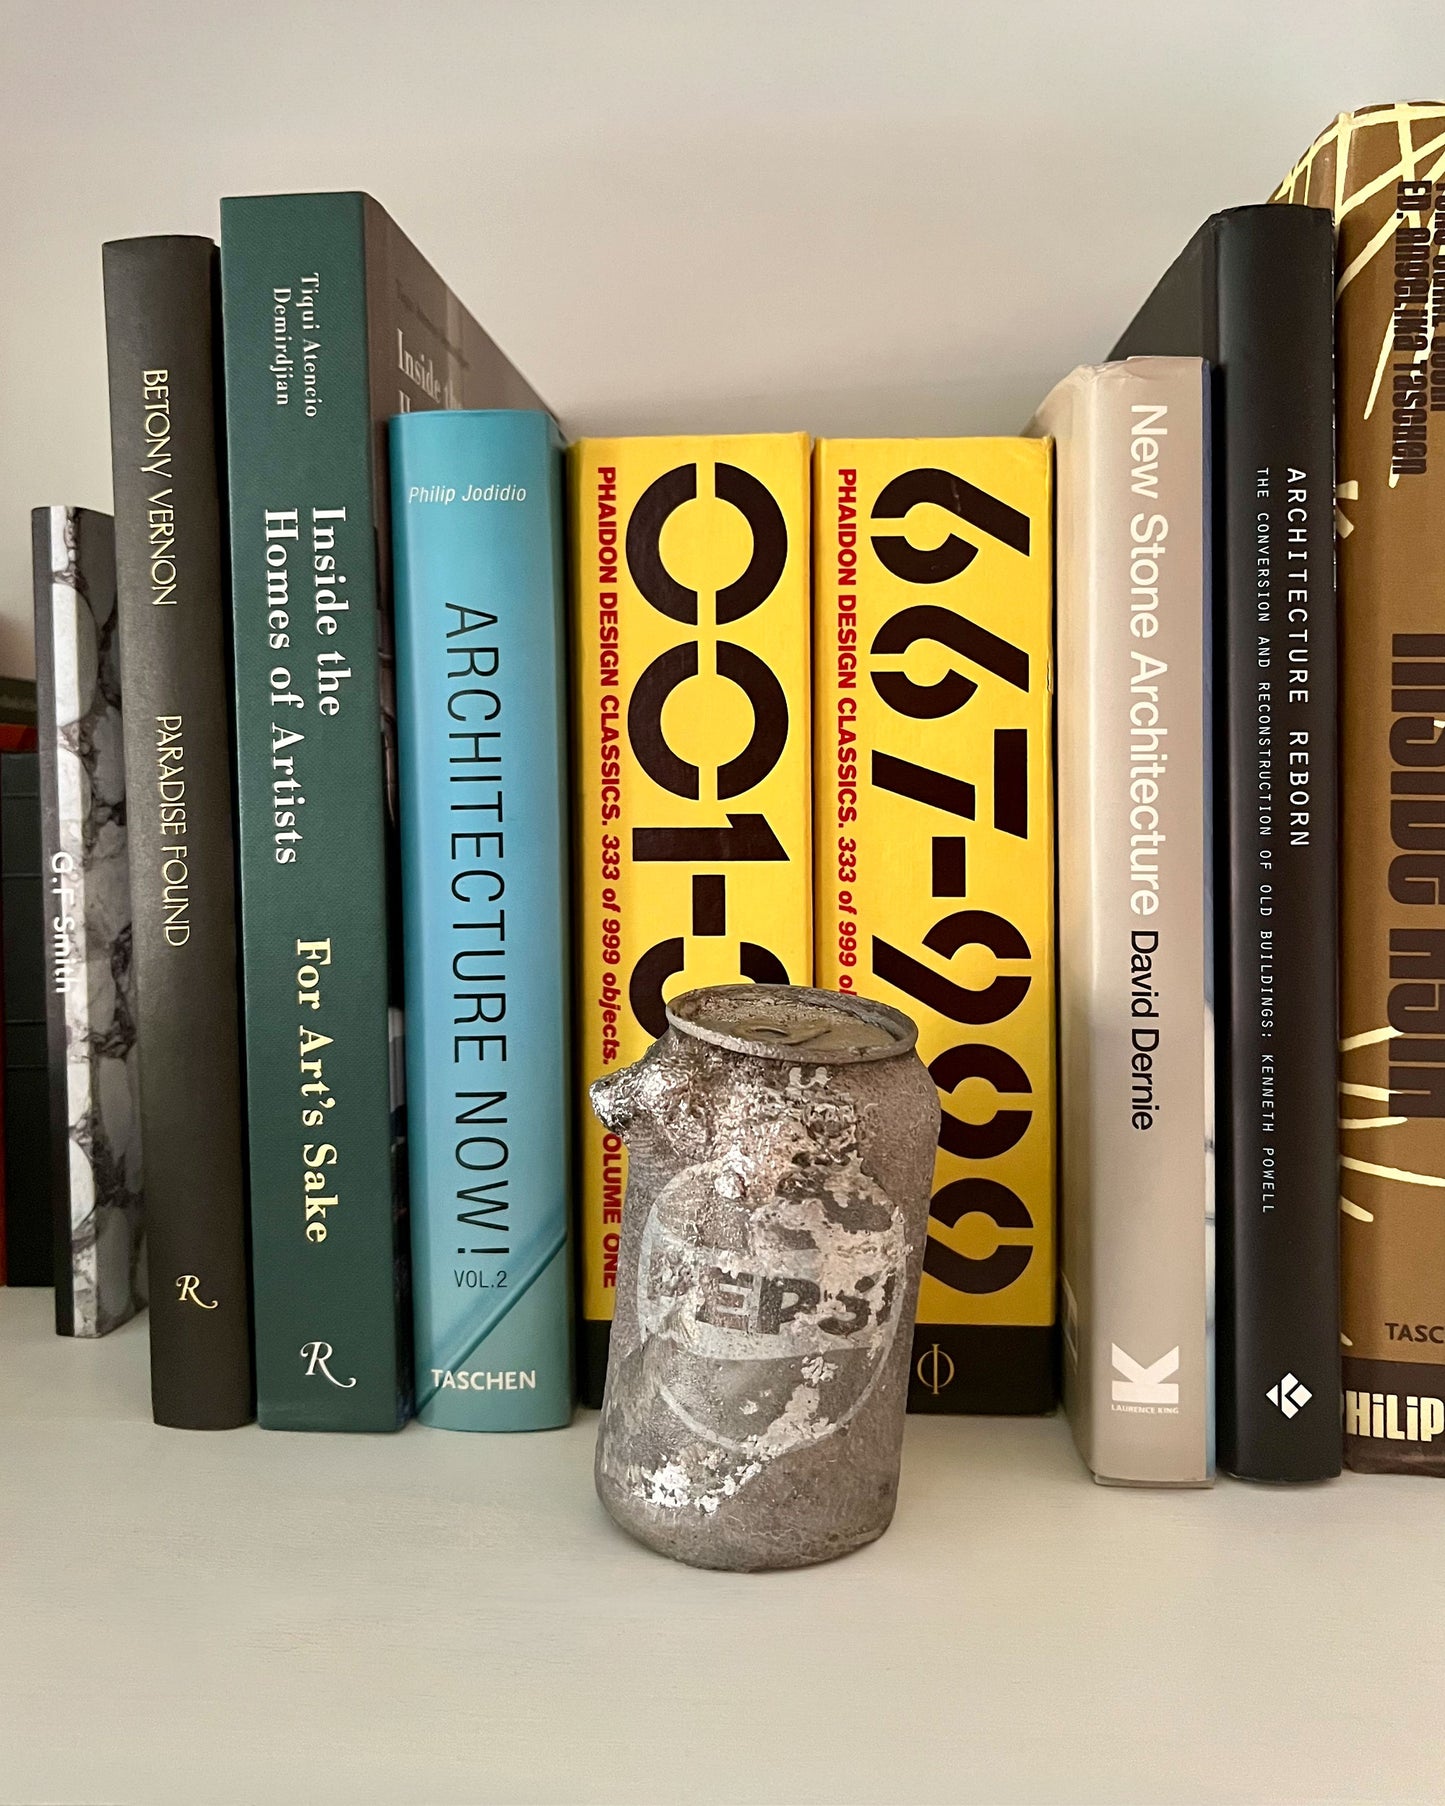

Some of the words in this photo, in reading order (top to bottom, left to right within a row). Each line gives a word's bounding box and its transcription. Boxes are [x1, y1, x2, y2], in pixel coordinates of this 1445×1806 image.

[269, 288, 293, 406] Demirdjian
[296, 273, 321, 330] Tiqui
[301, 336, 324, 417] Atencio
[397, 328, 441, 403] Inside
[141, 369, 172, 479] BETONY
[1130, 405, 1168, 499] New
[408, 486, 455, 506] Philip
[462, 484, 526, 503] Jodidio
[597, 466, 617, 583] PHAIDON
[838, 469, 857, 586] PHAIDON
[1257, 467, 1268, 499] THE
[148, 487, 177, 606] VERNON
[264, 509, 299, 650] Homes
[312, 507, 349, 636] Inside
[1130, 513, 1169, 639] Stone
[1257, 512, 1270, 622] CONVERSION
[1287, 467, 1309, 703] ARCHITECTURE
[317, 650, 352, 716] the
[599, 593, 620, 687] DESIGN
[838, 594, 857, 689] DESIGN
[1258, 636, 1270, 668] AND
[269, 667, 304, 709] of
[156, 715, 187, 835] PARADISE
[271, 722, 305, 865] Artists
[601, 697, 621, 827] CLASSICS.
[838, 698, 857, 828] CLASSICS.
[1130, 651, 1168, 915] Architecture
[1258, 682, 1271, 836] RECONSTRUCTION
[1289, 731, 1310, 846] REBORN
[445, 602, 507, 1063] ARCHITECTURE
[601, 834, 621, 883] 333
[838, 837, 857, 883] 333
[1259, 850, 1271, 870] OF
[161, 846, 190, 947] FOUND
[602, 887, 622, 912] of
[602, 918, 622, 964] 999
[838, 890, 858, 915] of
[1259, 885, 1272, 917] OLD
[52, 916, 78, 994] Smith
[297, 937, 332, 1010] For
[838, 921, 857, 967] 999
[1131, 930, 1159, 1018] David
[1260, 930, 1273, 1038] BUILDINGS:
[598, 970, 622, 1065] objects.
[299, 1024, 336, 1126] Art's
[1131, 1028, 1160, 1131] Dernie
[1261, 1054, 1274, 1132] KENNETH
[302, 1143, 340, 1244] Sake
[455, 1091, 510, 1254] NOW!
[603, 1134, 622, 1224] OLUME
[1262, 1147, 1274, 1213] POWELL
[454, 1269, 508, 1289] VOL.2
[603, 1231, 621, 1288] ONE
[431, 1368, 536, 1391] TASCHEN
[1111, 1404, 1155, 1414] LAURENCE
[1157, 1406, 1179, 1415] KING
